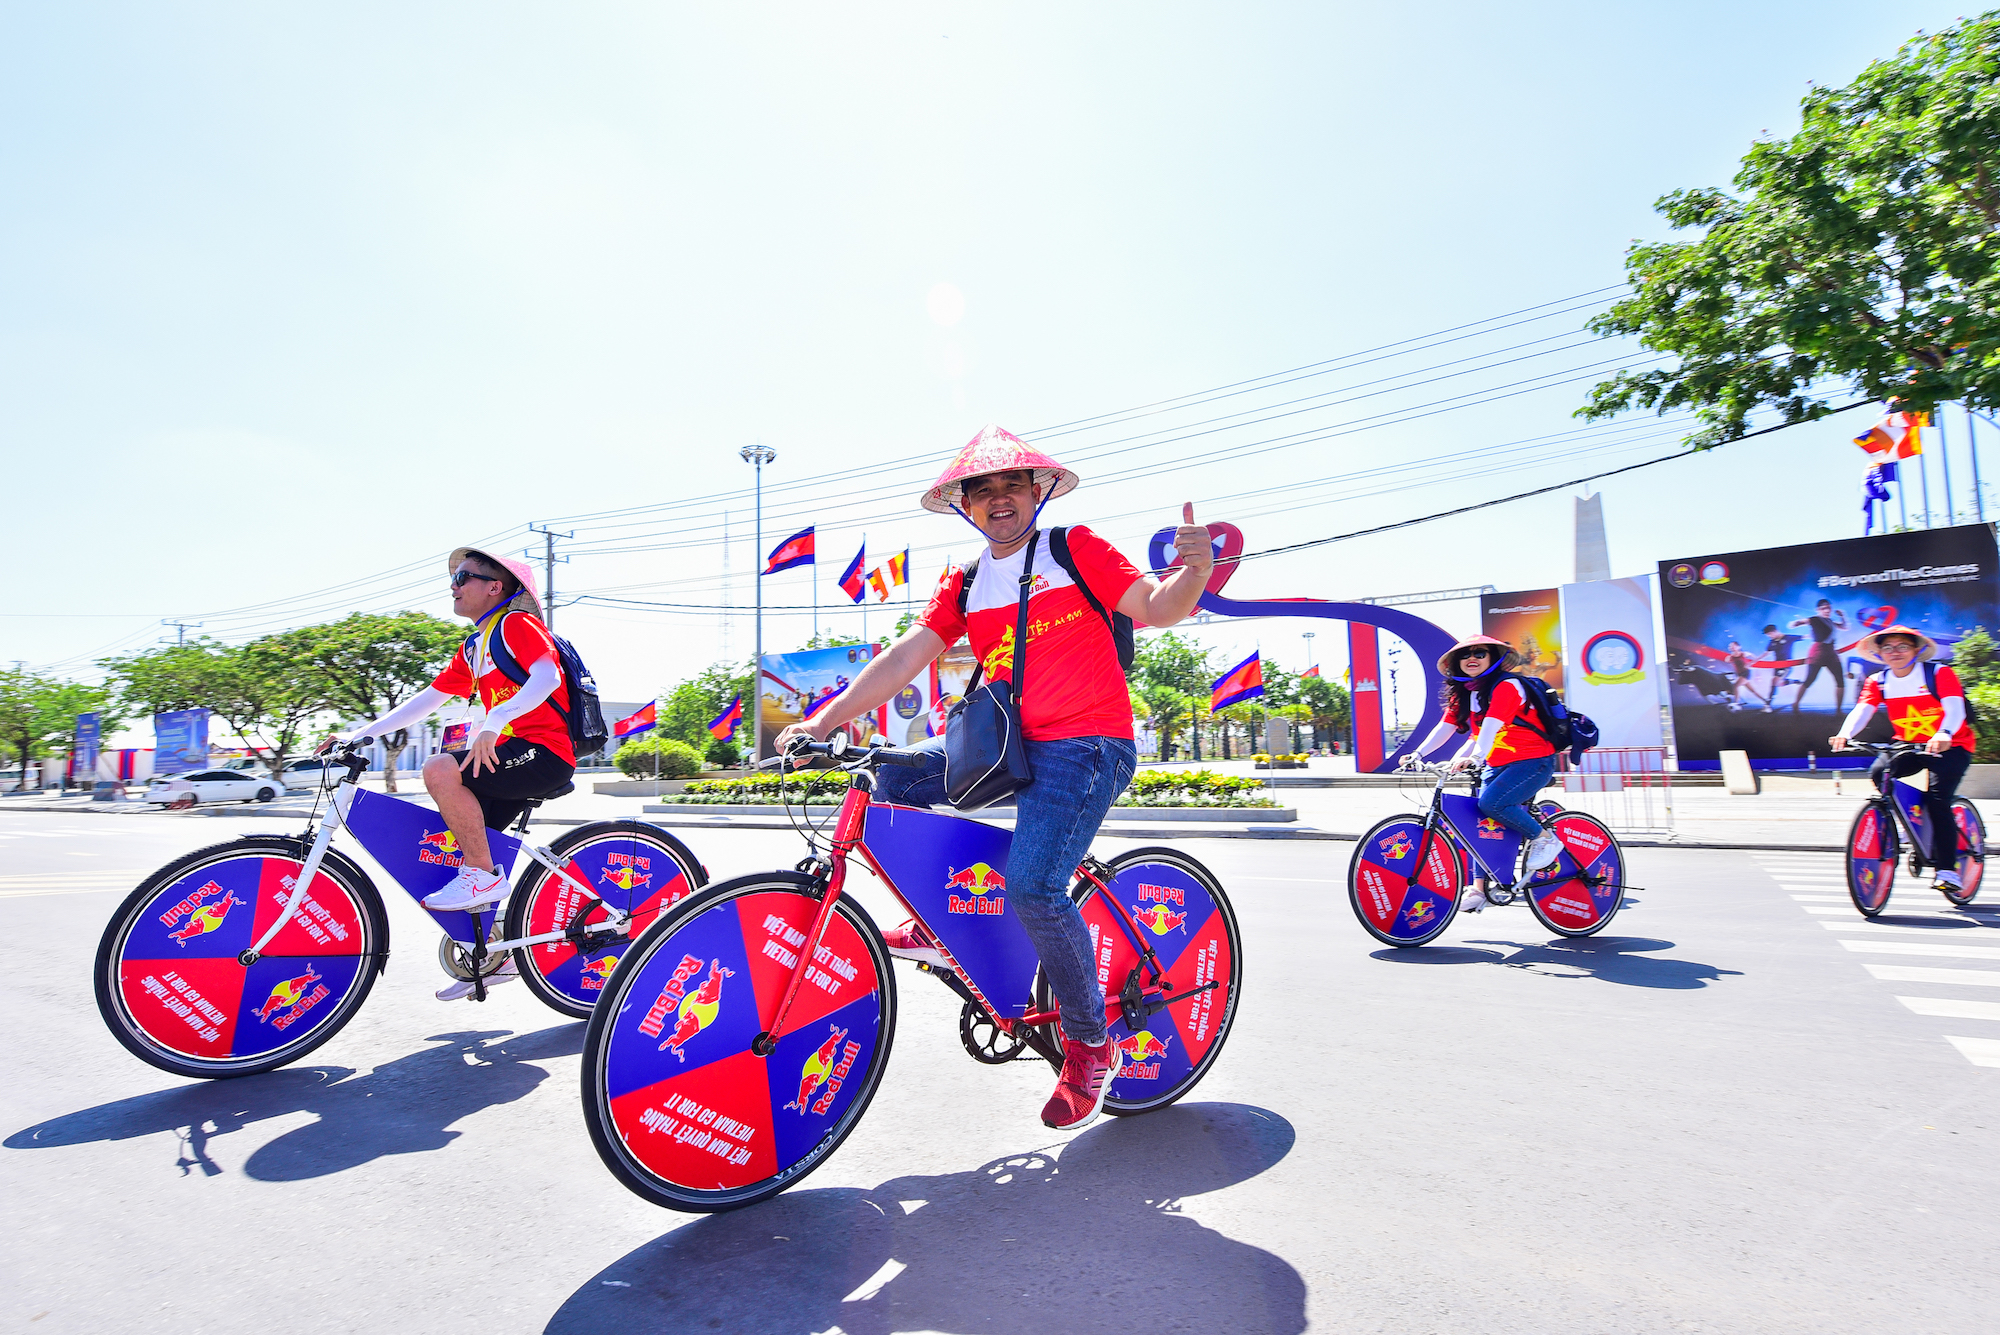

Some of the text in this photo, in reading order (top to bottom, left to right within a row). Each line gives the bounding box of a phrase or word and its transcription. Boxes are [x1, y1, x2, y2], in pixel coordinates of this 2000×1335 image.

[1817, 563, 1980, 588] #BeyondTheGames
[1379, 835, 1395, 850] Bull
[418, 849, 465, 868] Red Bul
[607, 852, 651, 870] Red Bull
[558, 880, 571, 899] THẮN
[570, 893, 581, 908] FOR
[1137, 883, 1185, 907] Red Bull
[158, 879, 224, 929] Red Bull
[554, 899, 567, 922] QUYẾT
[948, 894, 1004, 916] Red Bull
[297, 915, 313, 927] GO
[305, 923, 324, 940] FOR
[317, 935, 331, 945] IT
[305, 900, 331, 922] QUYẾT
[324, 918, 349, 941] THẮNG
[762, 914, 859, 982] VIỆT NAM YẾT THẮNG
[1102, 935, 1114, 947] IT
[1207, 939, 1218, 960] VIỆT
[761, 939, 842, 996] VIETNA O FOR IT
[1100, 947, 1113, 967] FOR
[1195, 948, 1207, 987] VIETNAM
[1098, 967, 1110, 983] GO
[1206, 959, 1216, 980] NAM
[580, 977, 602, 990] Red
[162, 971, 228, 1026] VIETNAM GO FOR IT
[270, 983, 332, 1032] Red Bull
[637, 953, 704, 1039] Red Bull
[141, 975, 221, 1043] VIỆT NAM QUYẾT THẮNG
[1189, 1002, 1200, 1020] FOR
[1187, 1021, 1197, 1032] IT
[1196, 1012, 1209, 1042] THẮNG
[812, 1039, 862, 1116] Red Bull
[1116, 1062, 1160, 1080] ed Bull
[663, 1092, 756, 1143] VIETNAM GO FOR IT
[639, 1107, 753, 1166] VIỆT NAM QUYẾT THẮNG
